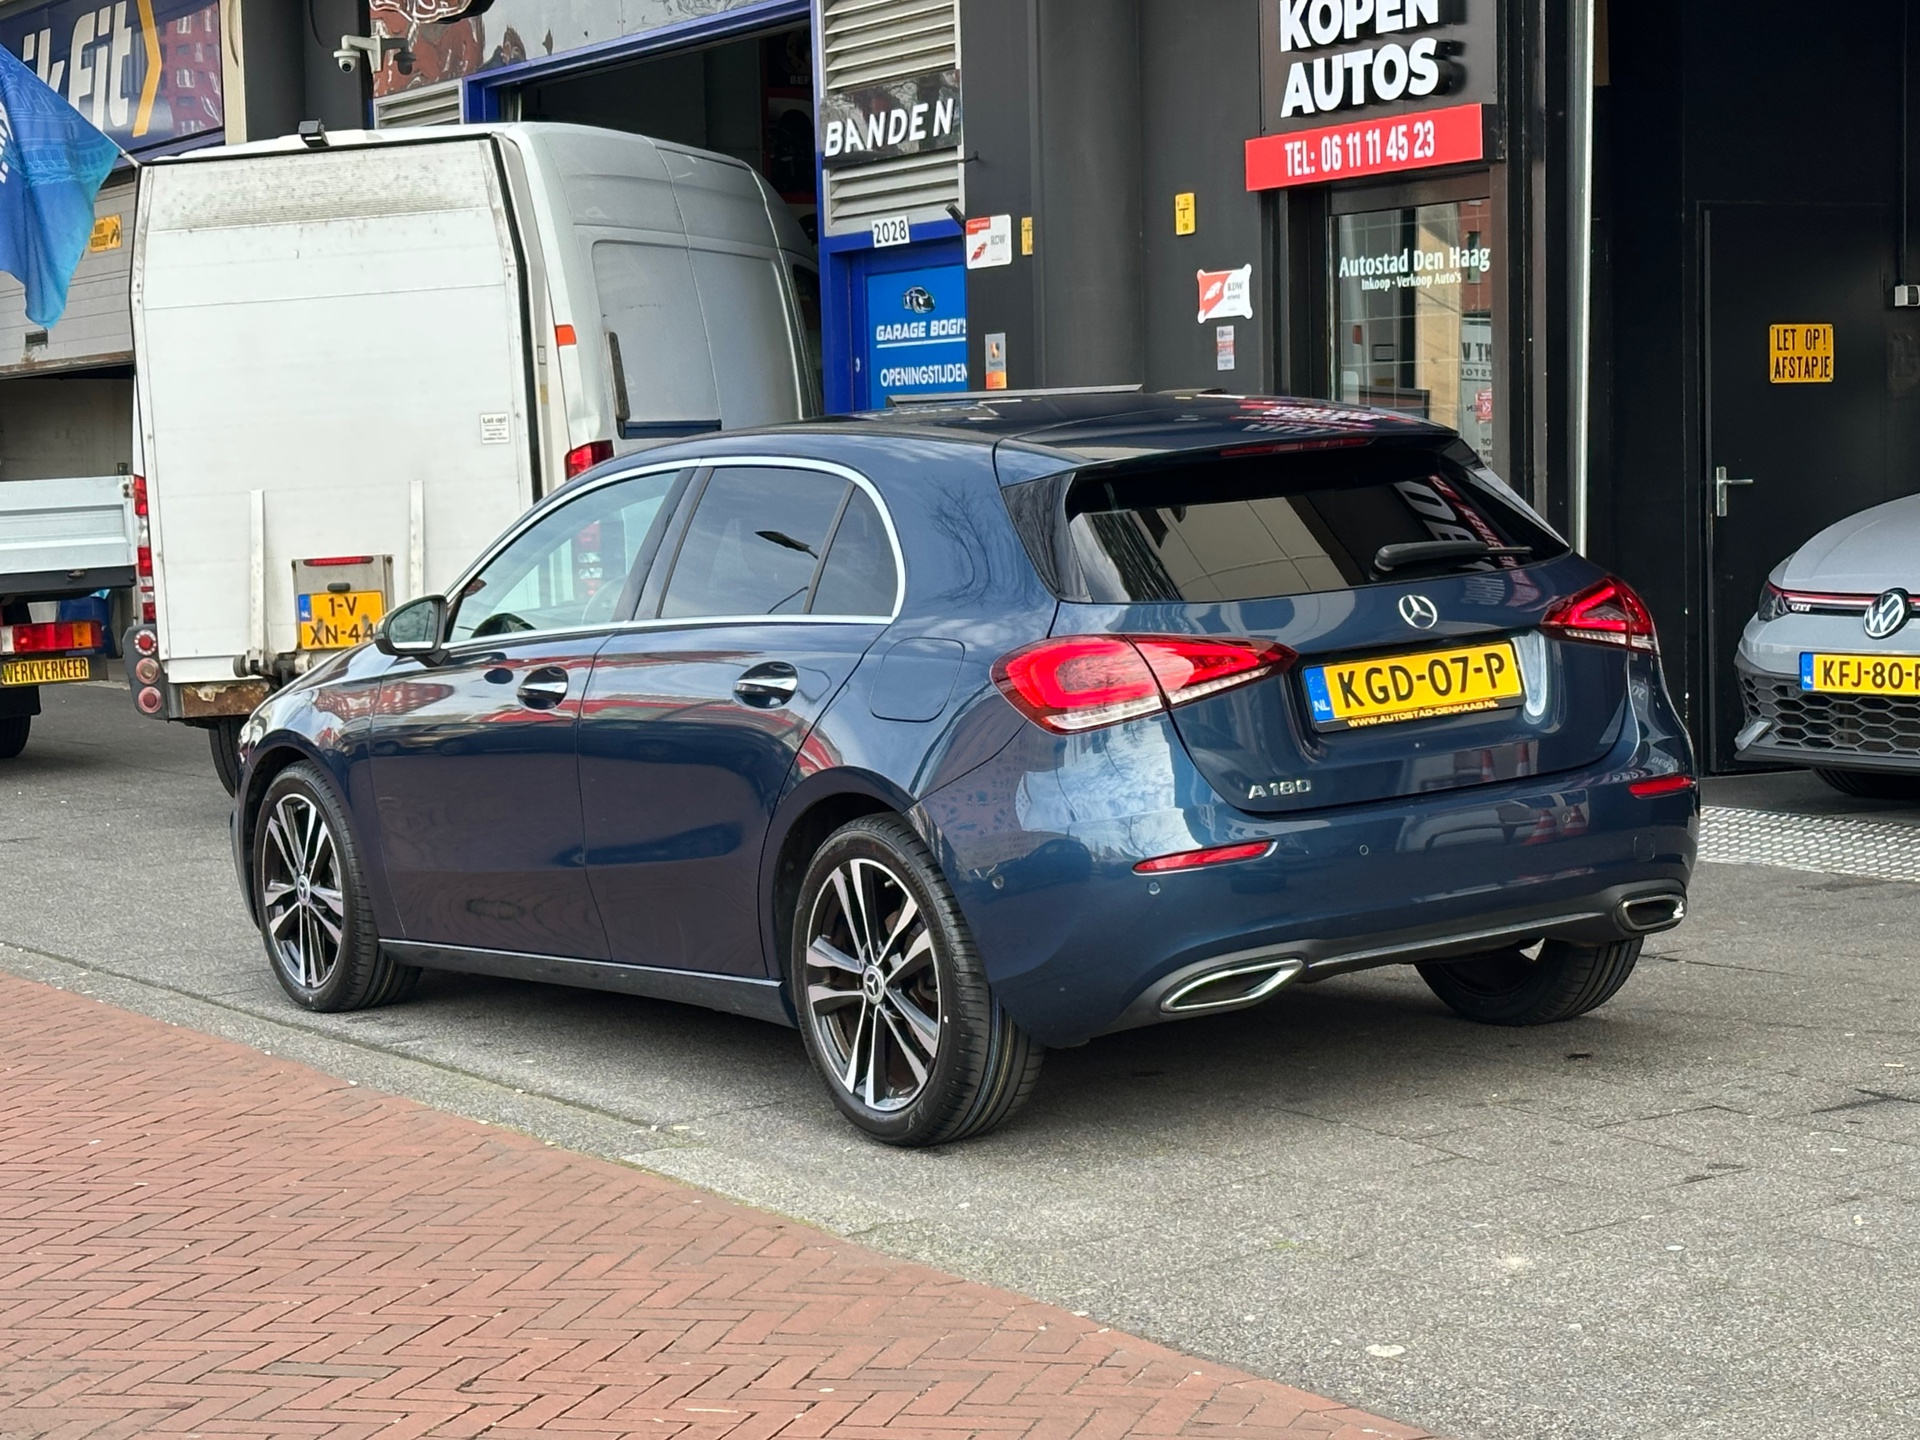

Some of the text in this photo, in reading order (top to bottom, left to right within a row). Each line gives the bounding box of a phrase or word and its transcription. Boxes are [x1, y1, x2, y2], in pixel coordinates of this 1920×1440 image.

[1279, 0, 1439, 52] KOPEN
[1280, 37, 1440, 118] AUTOS
[824, 98, 955, 157] BANDEN
[1284, 119, 1436, 177] TEL: 06 11 11 45 23
[873, 220, 908, 245] 2028
[1338, 246, 1491, 278] Autostad Den Haag
[1361, 275, 1391, 292] Inkoop
[1396, 273, 1432, 289] Verkoop
[1434, 270, 1462, 285] Auto's
[876, 320, 927, 342] GARAGE
[1776, 328, 1826, 351] LET OP!
[1774, 355, 1831, 379] AFSTAPJE
[328, 596, 358, 617] 1-V
[309, 622, 375, 646] XN-44
[3, 659, 88, 683] WERKVERKEER
[1337, 652, 1505, 709] KGD-07-P
[1313, 700, 1330, 712] NL
[1248, 780, 1312, 800] A 180
